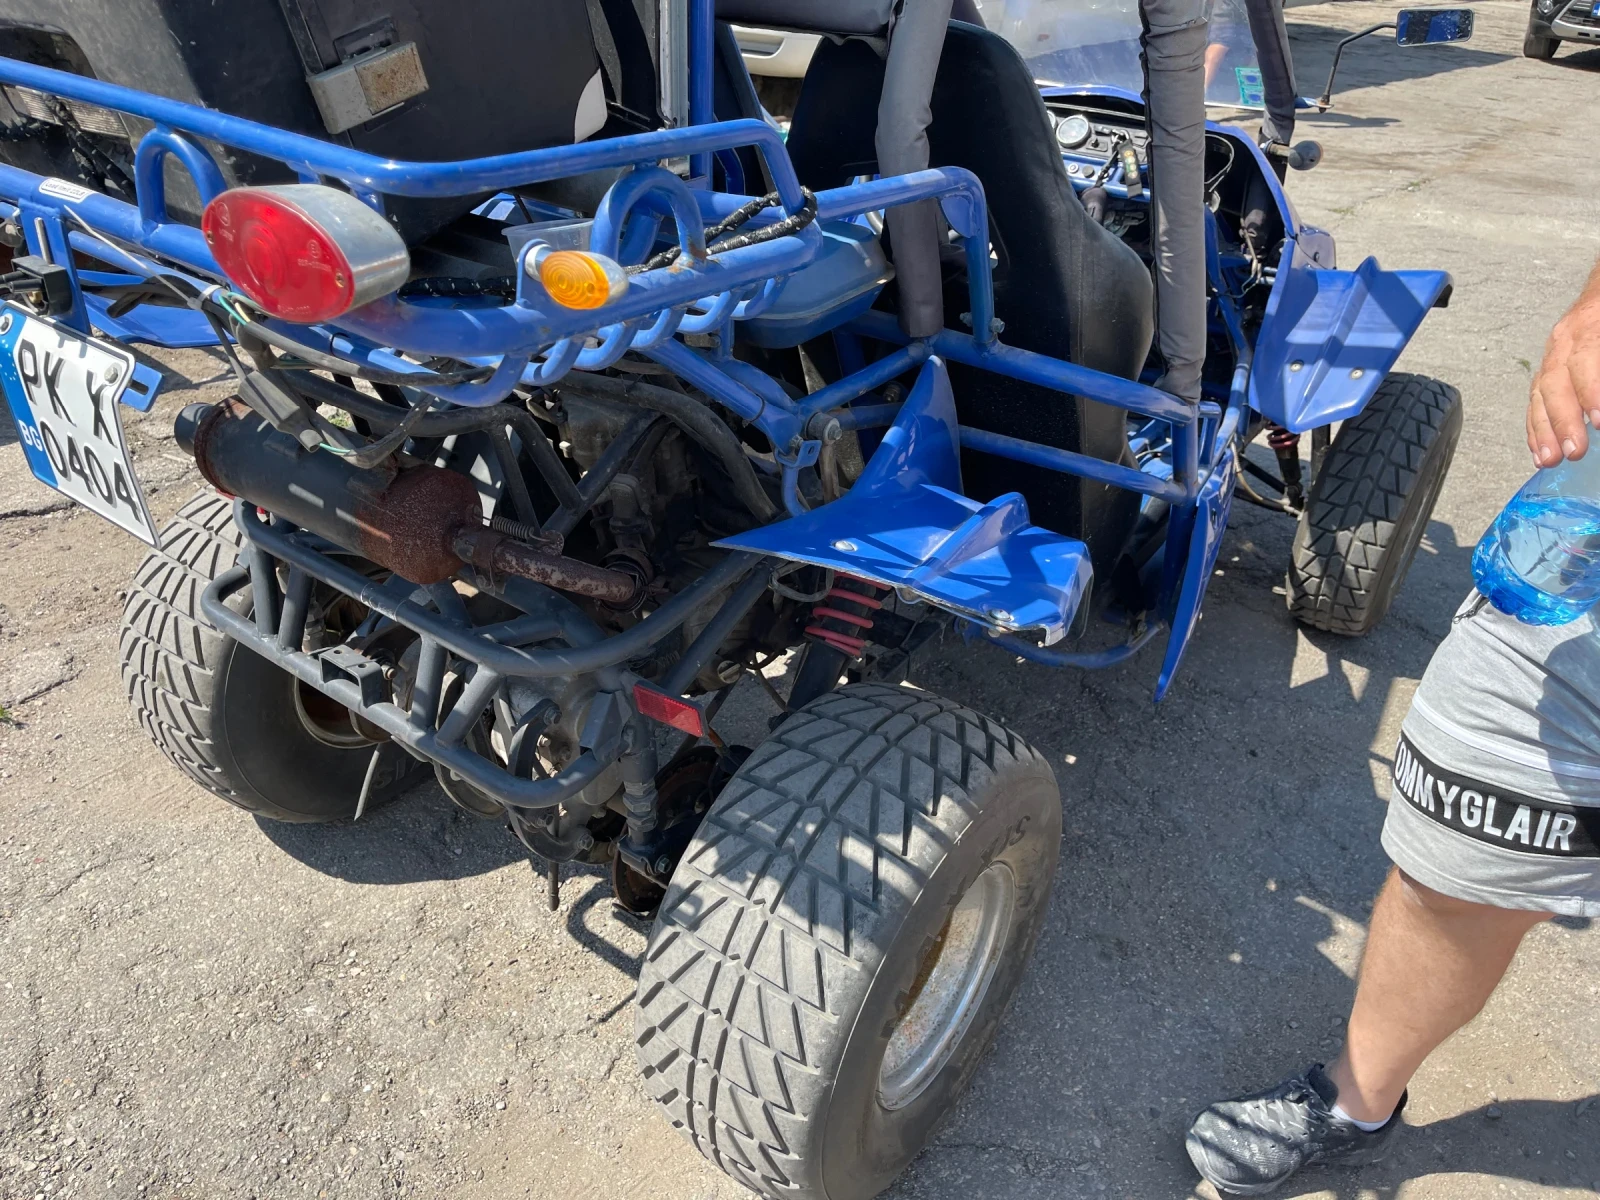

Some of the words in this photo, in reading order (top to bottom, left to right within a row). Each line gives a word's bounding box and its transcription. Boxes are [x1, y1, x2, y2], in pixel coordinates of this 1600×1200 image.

[18, 338, 77, 427] PK
[86, 369, 118, 449] X
[18, 420, 43, 452] BG
[40, 420, 144, 526] 0404
